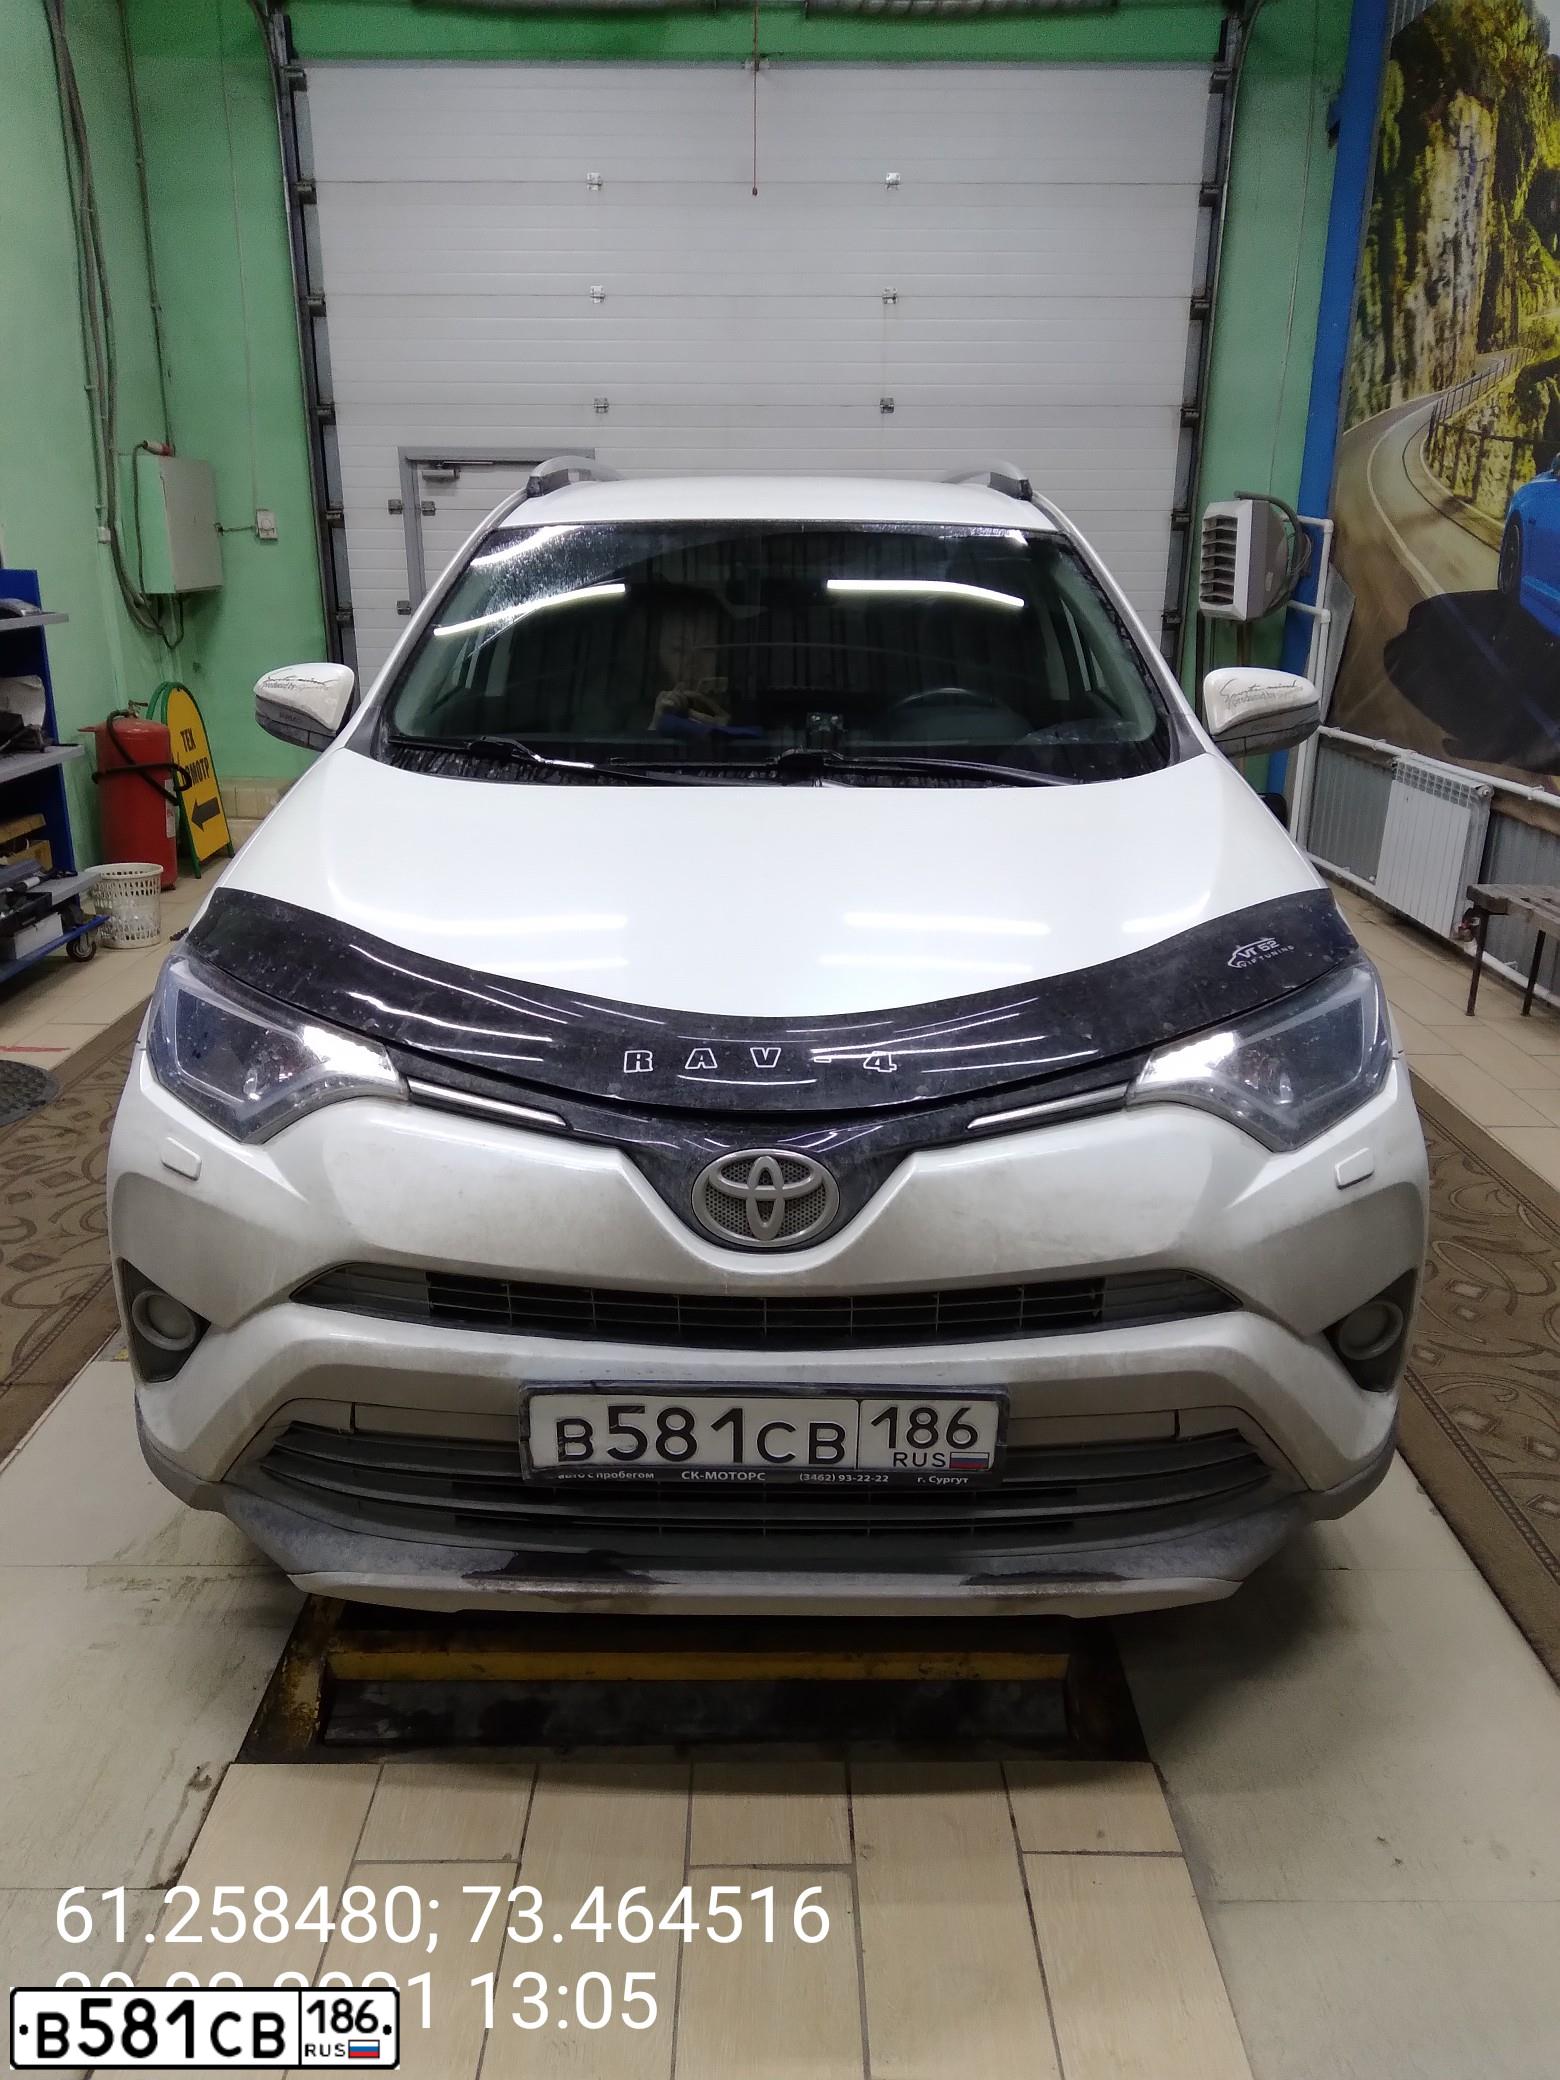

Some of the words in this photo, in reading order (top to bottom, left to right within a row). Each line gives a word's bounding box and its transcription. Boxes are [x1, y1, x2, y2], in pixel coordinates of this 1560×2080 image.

[180, 727, 196, 752] ТЕХ
[184, 757, 210, 786] МОТР
[871, 1406, 978, 1450] 186
[892, 1451, 946, 1468] RUS
[597, 1471, 654, 1480] пробегом
[681, 1471, 766, 1481] СК-МОТОРС
[799, 1474, 836, 1483] (3462)
[838, 1474, 889, 1483] 93-22-22
[928, 1476, 968, 1485] Сургут
